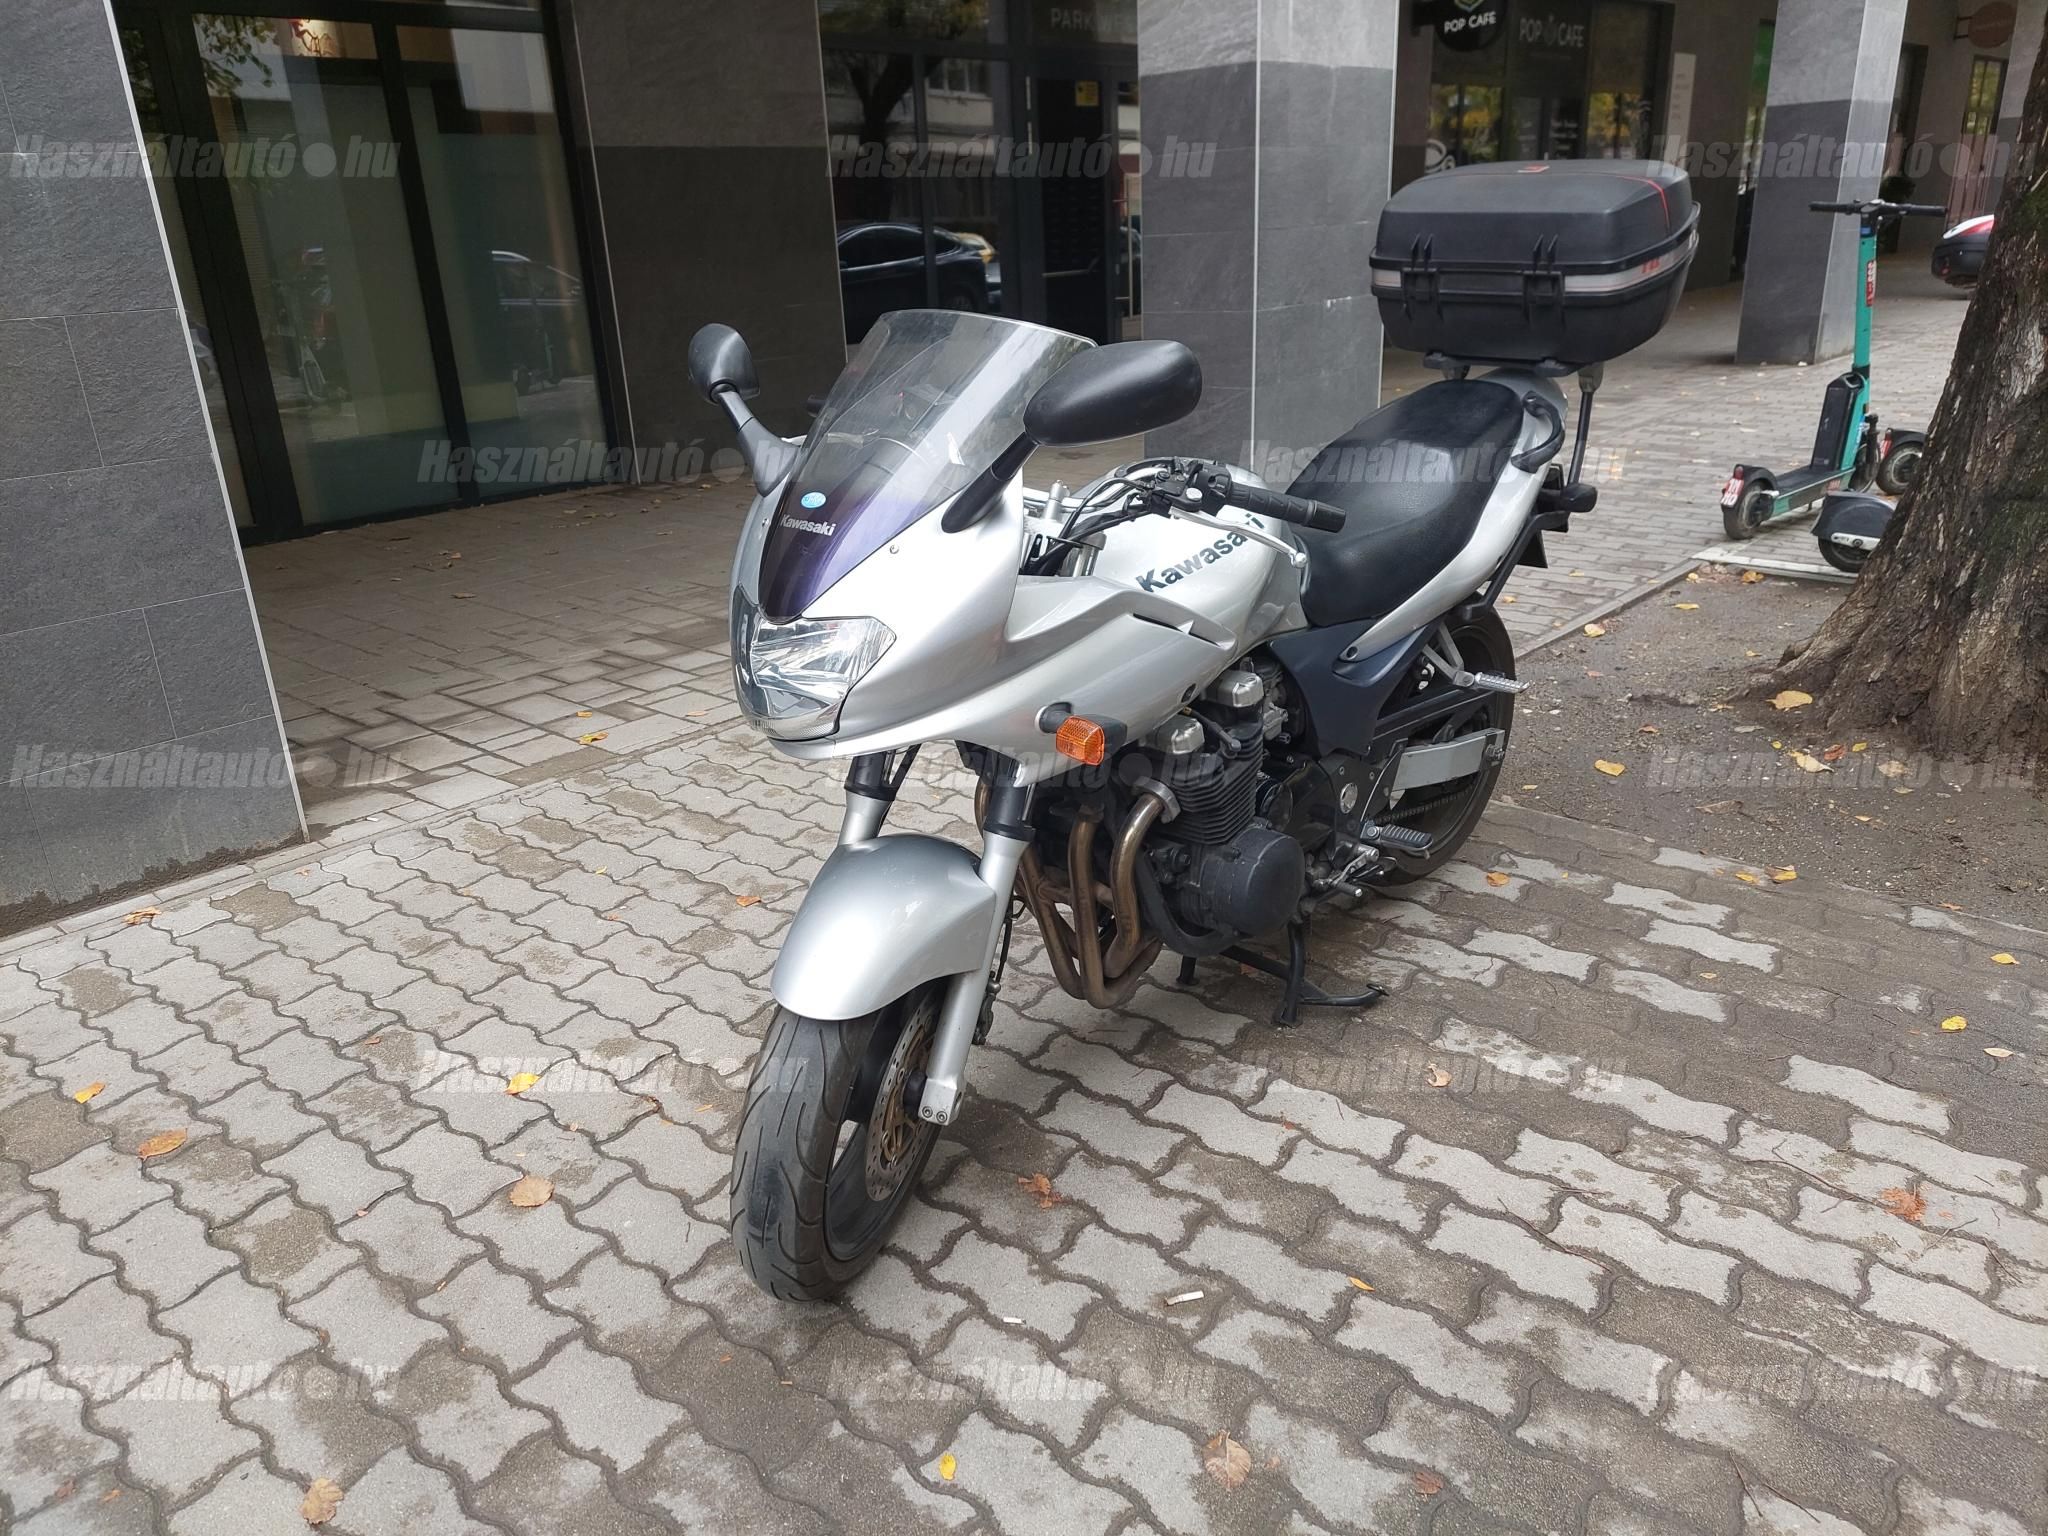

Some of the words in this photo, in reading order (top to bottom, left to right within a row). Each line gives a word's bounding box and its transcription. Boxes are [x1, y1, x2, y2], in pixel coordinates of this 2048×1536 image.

[1444, 20, 1466, 34] POP
[1519, 18, 1541, 42] POP
[781, 514, 836, 536] Kawasaki
[1135, 512, 1265, 593] Kawasai
